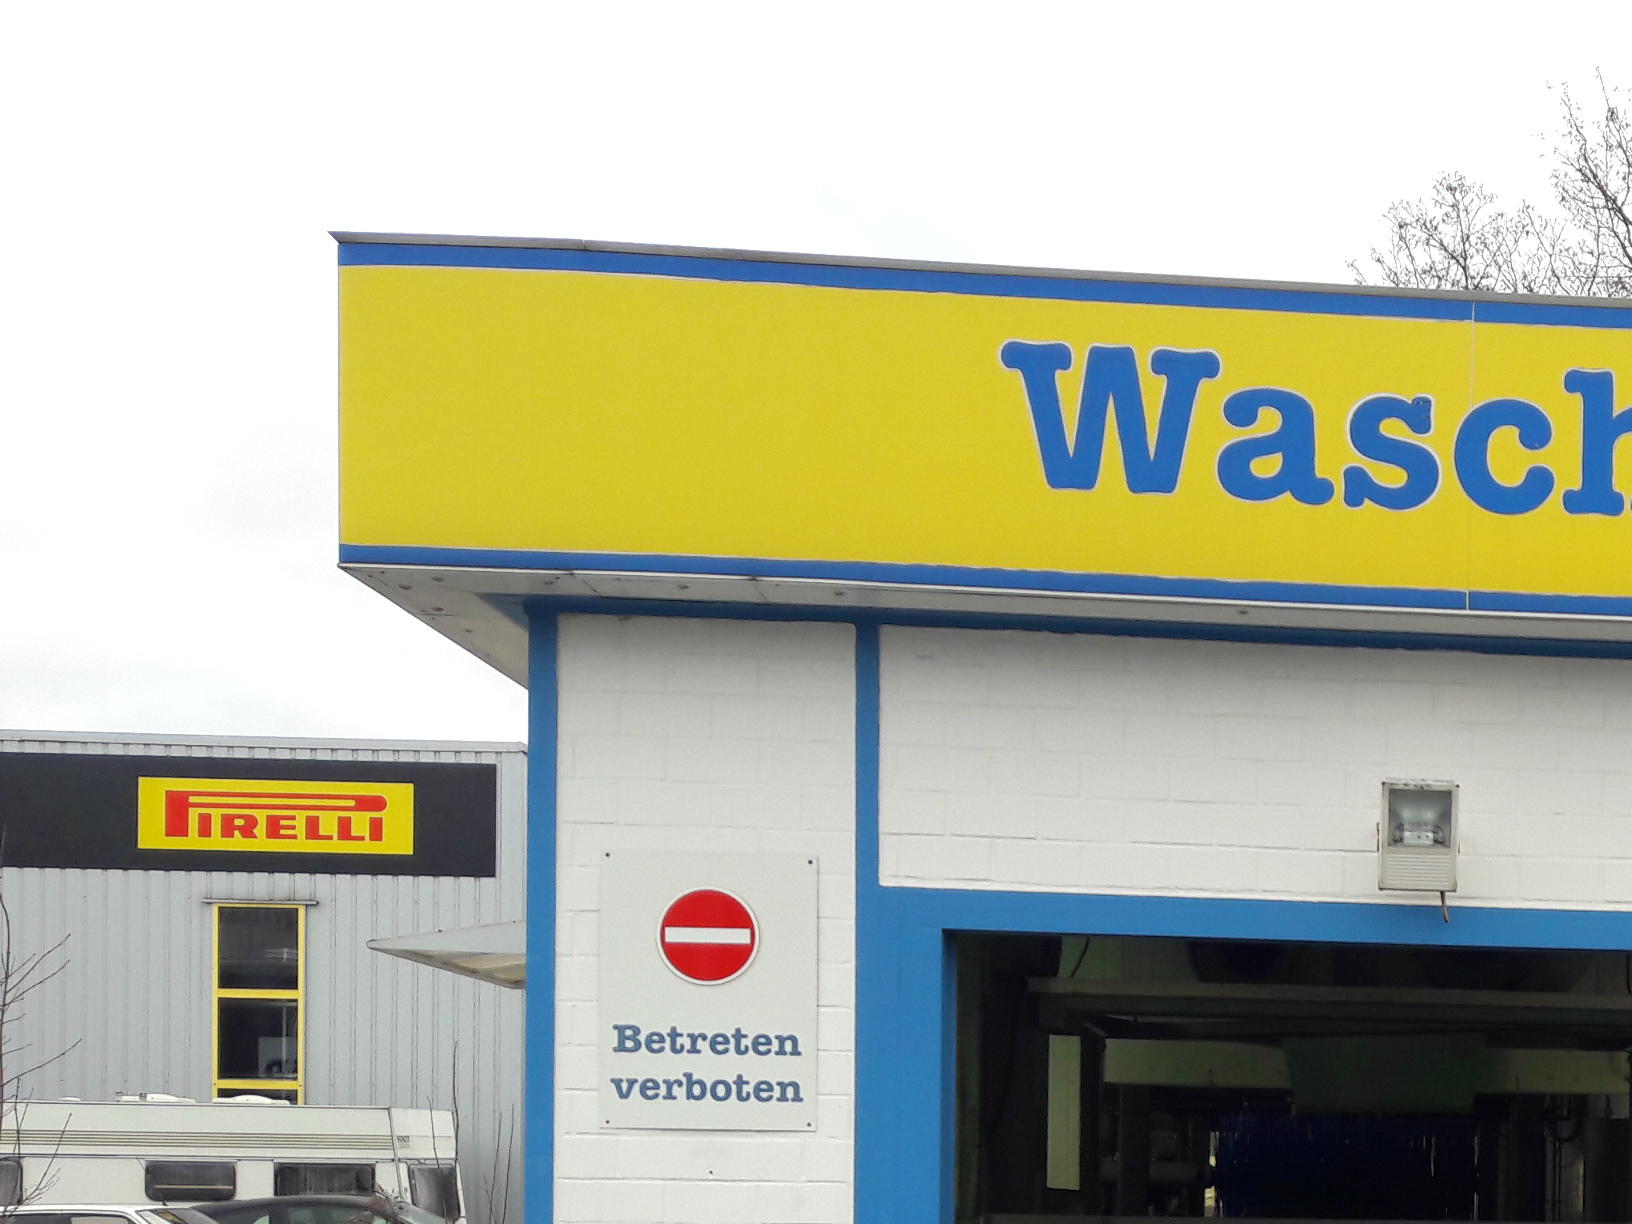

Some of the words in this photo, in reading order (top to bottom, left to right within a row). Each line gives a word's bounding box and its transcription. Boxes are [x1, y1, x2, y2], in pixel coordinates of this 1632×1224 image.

[165, 790, 387, 842] PIRELLI
[612, 1024, 802, 1056] Betreten
[610, 1072, 804, 1102] verboten
